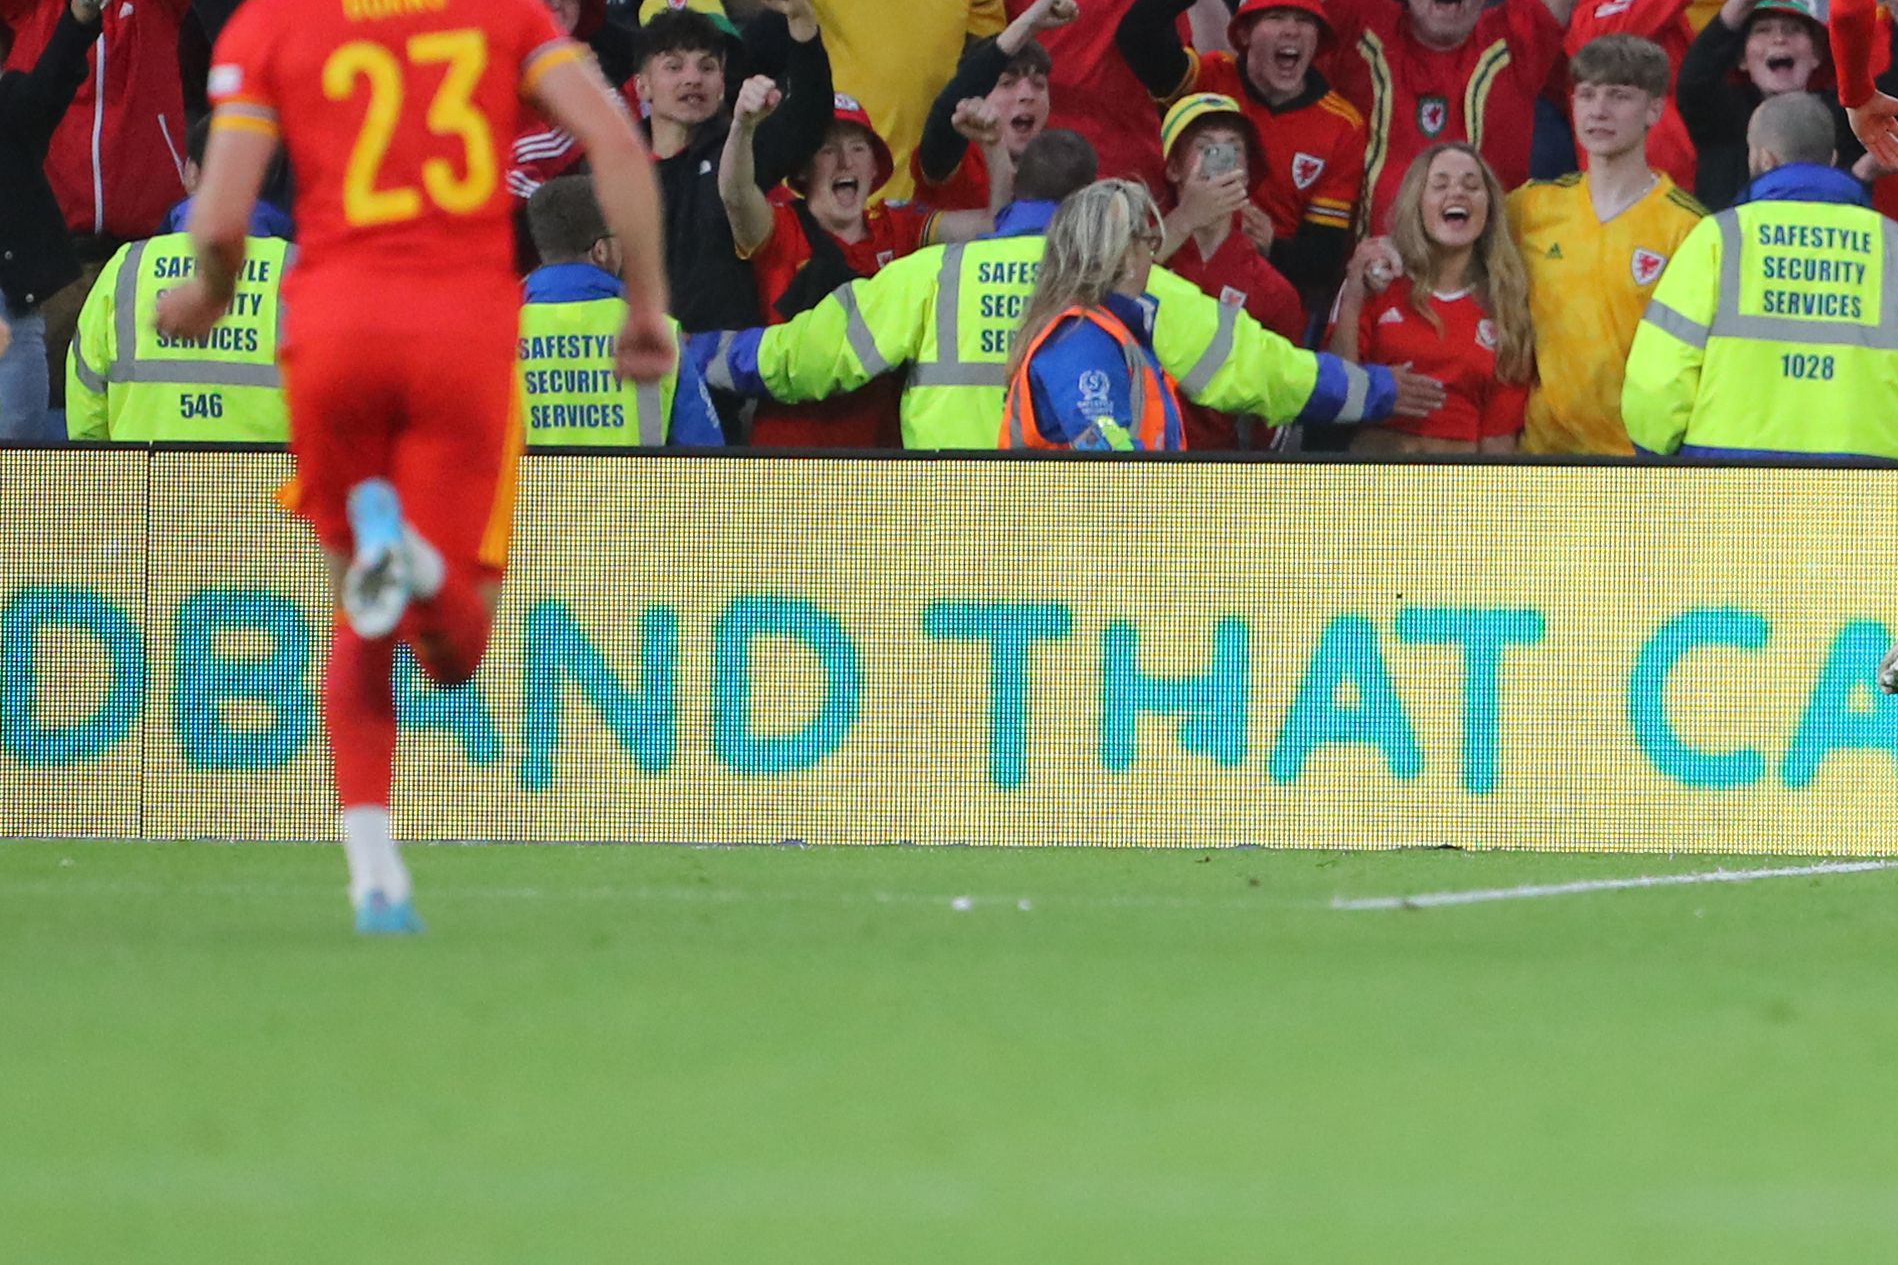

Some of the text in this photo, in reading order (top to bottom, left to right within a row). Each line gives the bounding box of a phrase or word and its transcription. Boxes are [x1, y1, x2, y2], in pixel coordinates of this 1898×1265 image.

[321, 27, 499, 227] 23
[1758, 223, 1872, 254] SAFESTYLE
[1763, 255, 1866, 285] SECURITY
[1763, 289, 1862, 319] SERVICES
[519, 335, 619, 360] SAFESTYL
[1781, 353, 1835, 380] 1028
[180, 393, 223, 419] 546
[531, 404, 625, 429] SERVICES
[922, 598, 1546, 794] THAT
